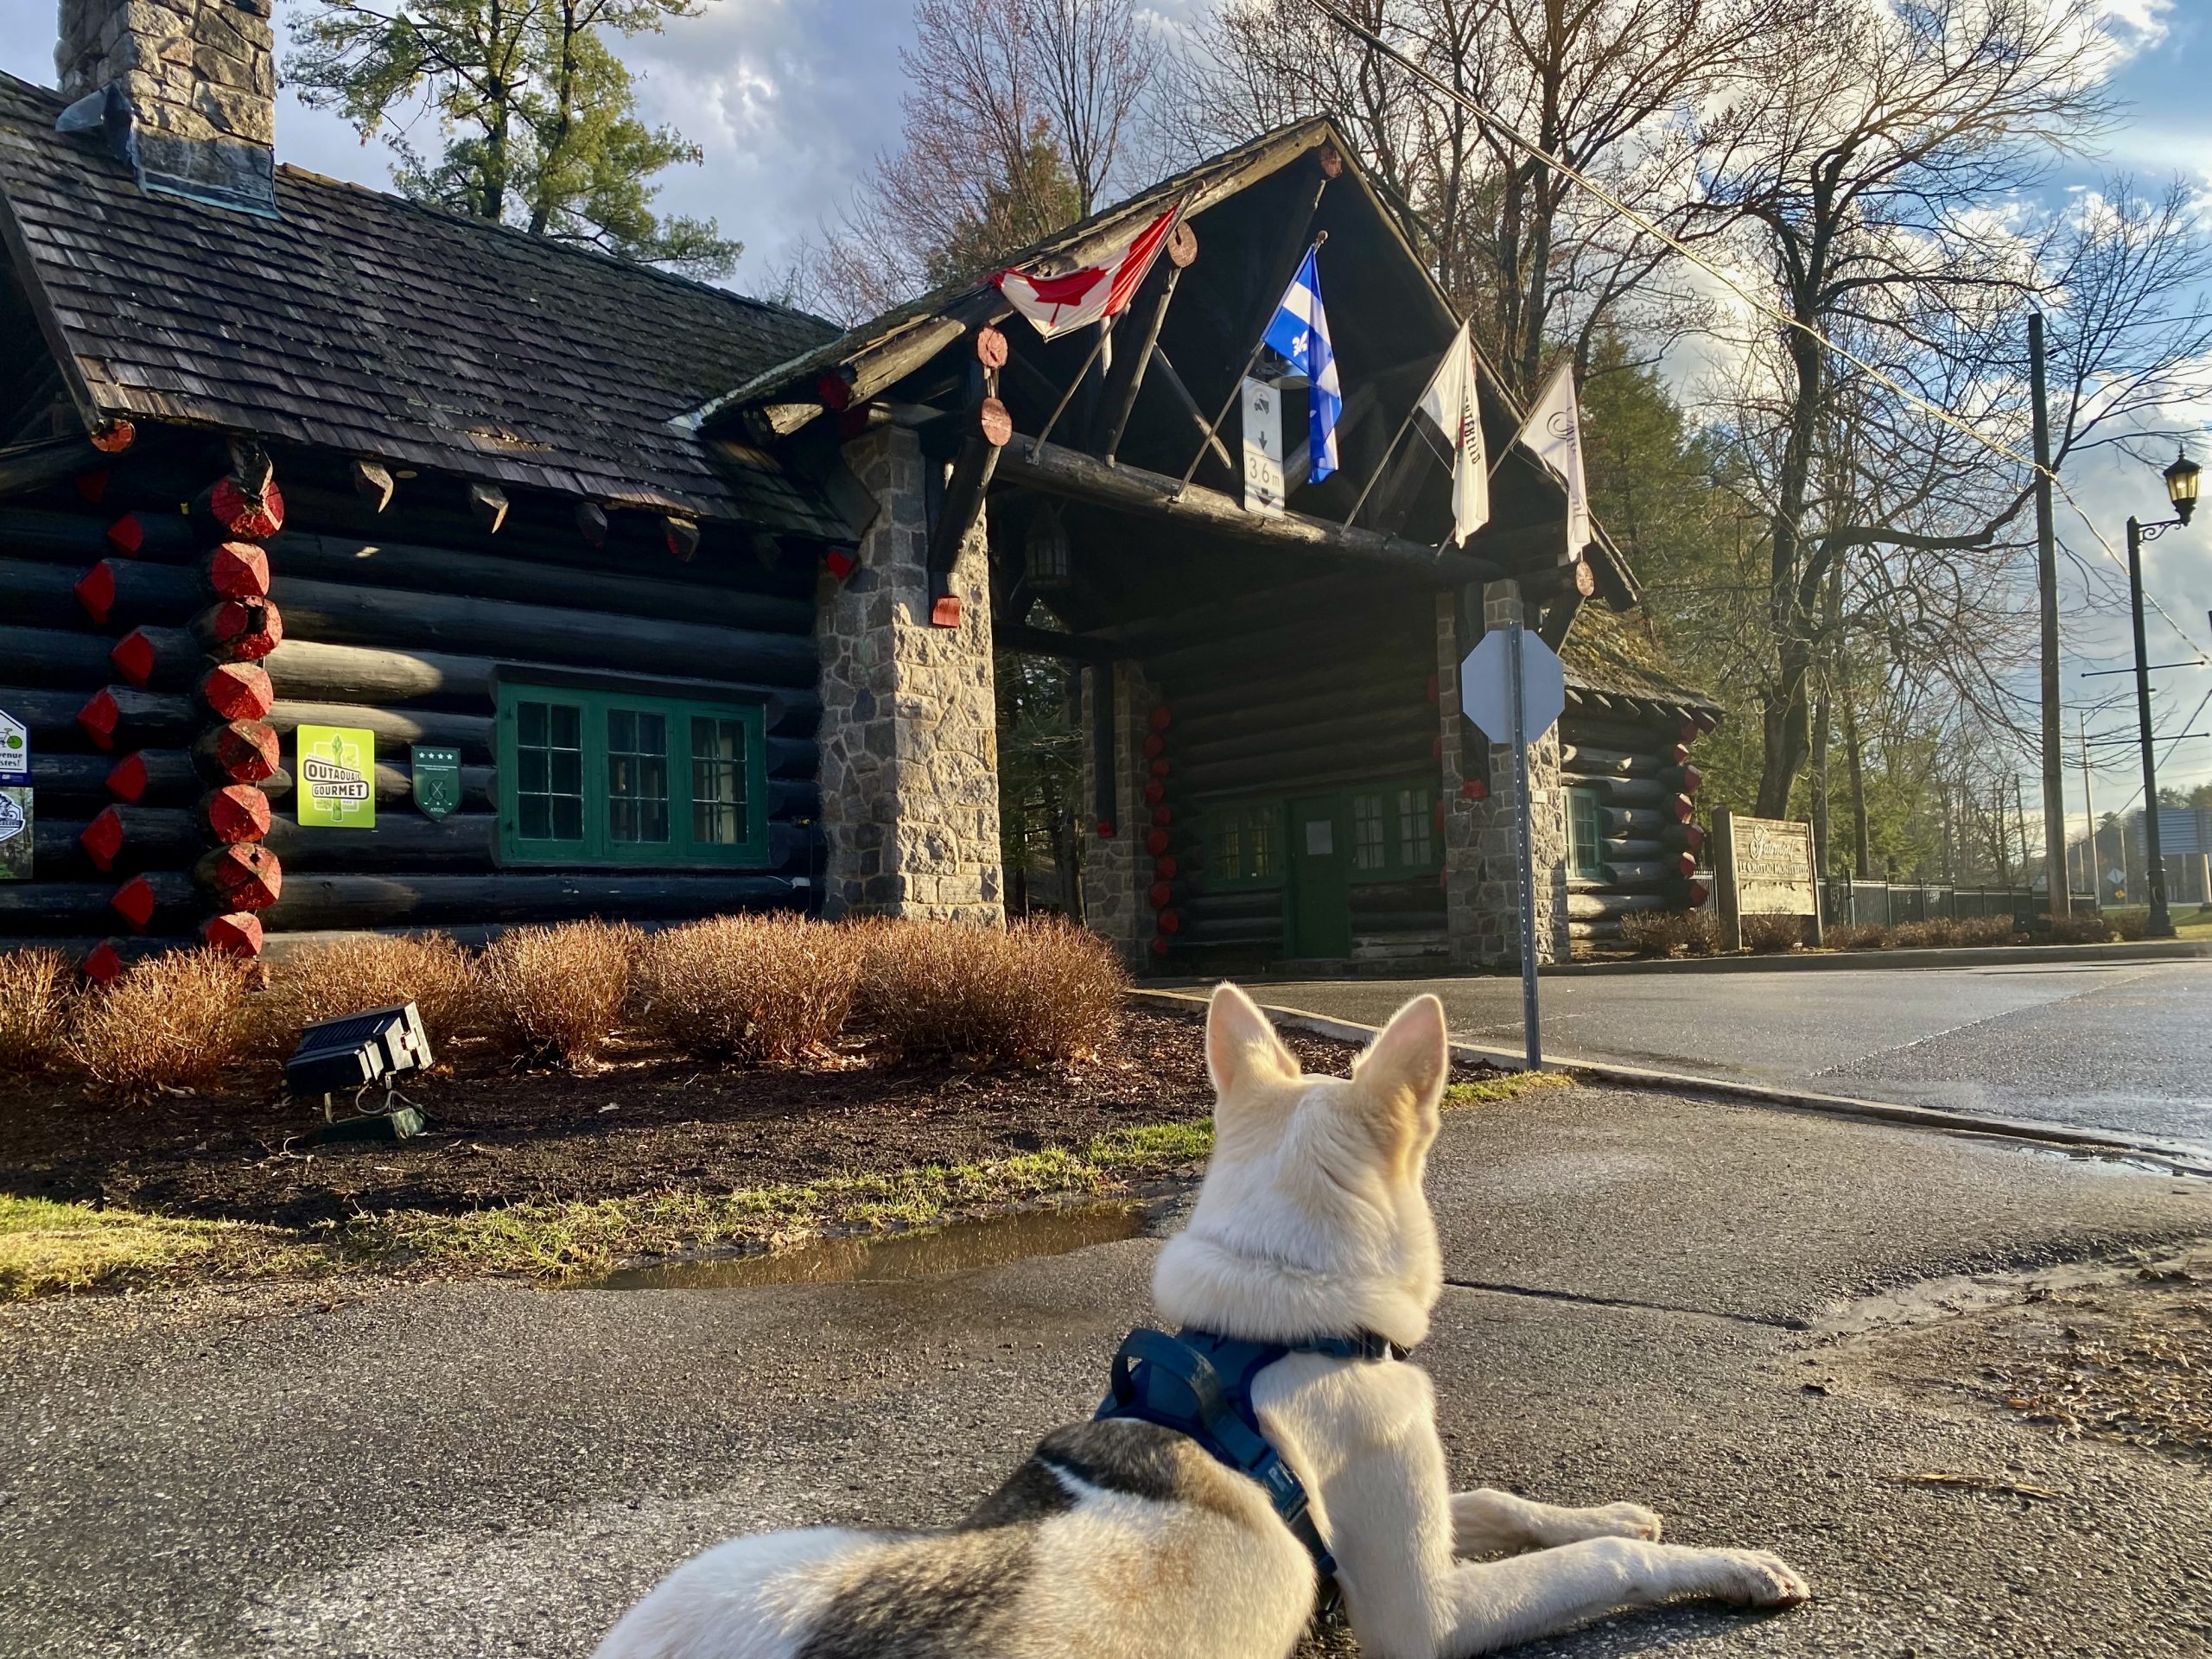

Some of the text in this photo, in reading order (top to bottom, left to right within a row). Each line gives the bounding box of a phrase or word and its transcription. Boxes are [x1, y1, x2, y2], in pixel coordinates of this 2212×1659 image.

[308, 764, 360, 781] OUTAOUAIS
[314, 785, 363, 796] GOURMET
[1749, 823, 1795, 862] Fairmont
